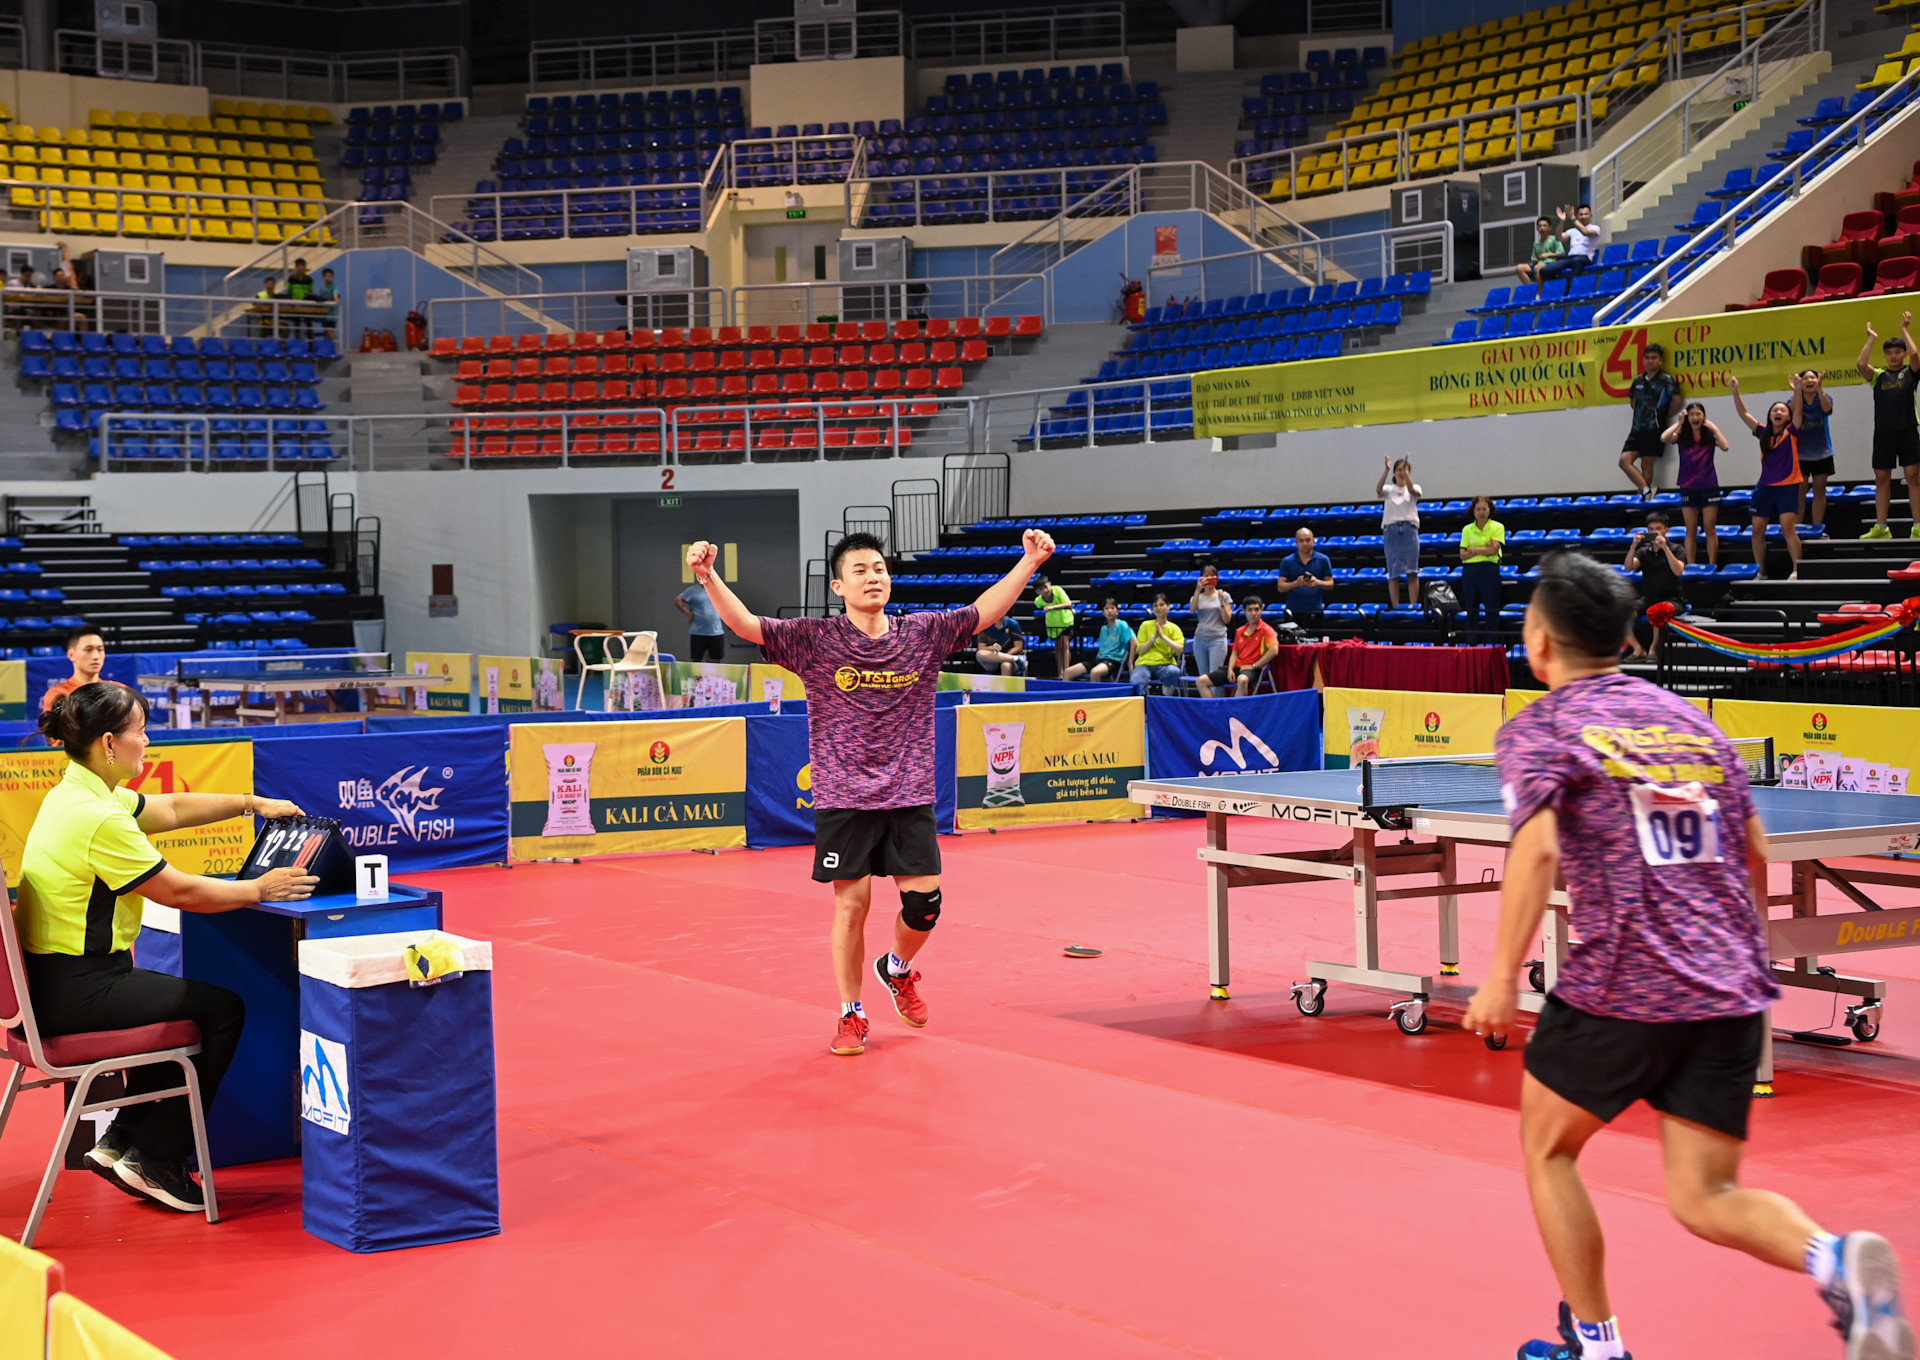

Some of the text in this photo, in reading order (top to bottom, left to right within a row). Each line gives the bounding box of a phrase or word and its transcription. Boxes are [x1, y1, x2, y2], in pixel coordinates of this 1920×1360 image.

[1674, 325, 1712, 346] CÚP
[1482, 345, 1514, 365] GIẢI
[1520, 340, 1541, 361] VÔ
[1674, 336, 1826, 368] PETROVIETNAM
[1430, 360, 1587, 391] BÓNG BÀN QUỐC GIA
[1469, 381, 1585, 409] BÁO NHÂN DÂN
[661, 469, 675, 489] 2
[660, 498, 680, 506] EXIT
[993, 750, 1015, 763] NPK
[1043, 751, 1120, 768] NPK CÀ MAU
[557, 785, 582, 793] KALI
[1047, 778, 1066, 788] Chất
[1067, 778, 1090, 788] lượng
[1090, 776, 1098, 784] đi
[1813, 775, 1833, 785] NPK
[1095, 787, 1108, 795] lâu
[605, 801, 726, 825] KALI CÀ MAU
[1197, 801, 1211, 810] FISH
[1272, 803, 1359, 827] MOFIT
[418, 818, 455, 842] FISH
[156, 835, 243, 849] PETROVIETNAM
[209, 847, 243, 857] PVCFC
[256, 828, 287, 867] 12
[203, 857, 245, 874] 2023
[363, 862, 382, 888] T
[1837, 920, 1908, 946] DOUBLE
[303, 1103, 348, 1131] MOFIT
